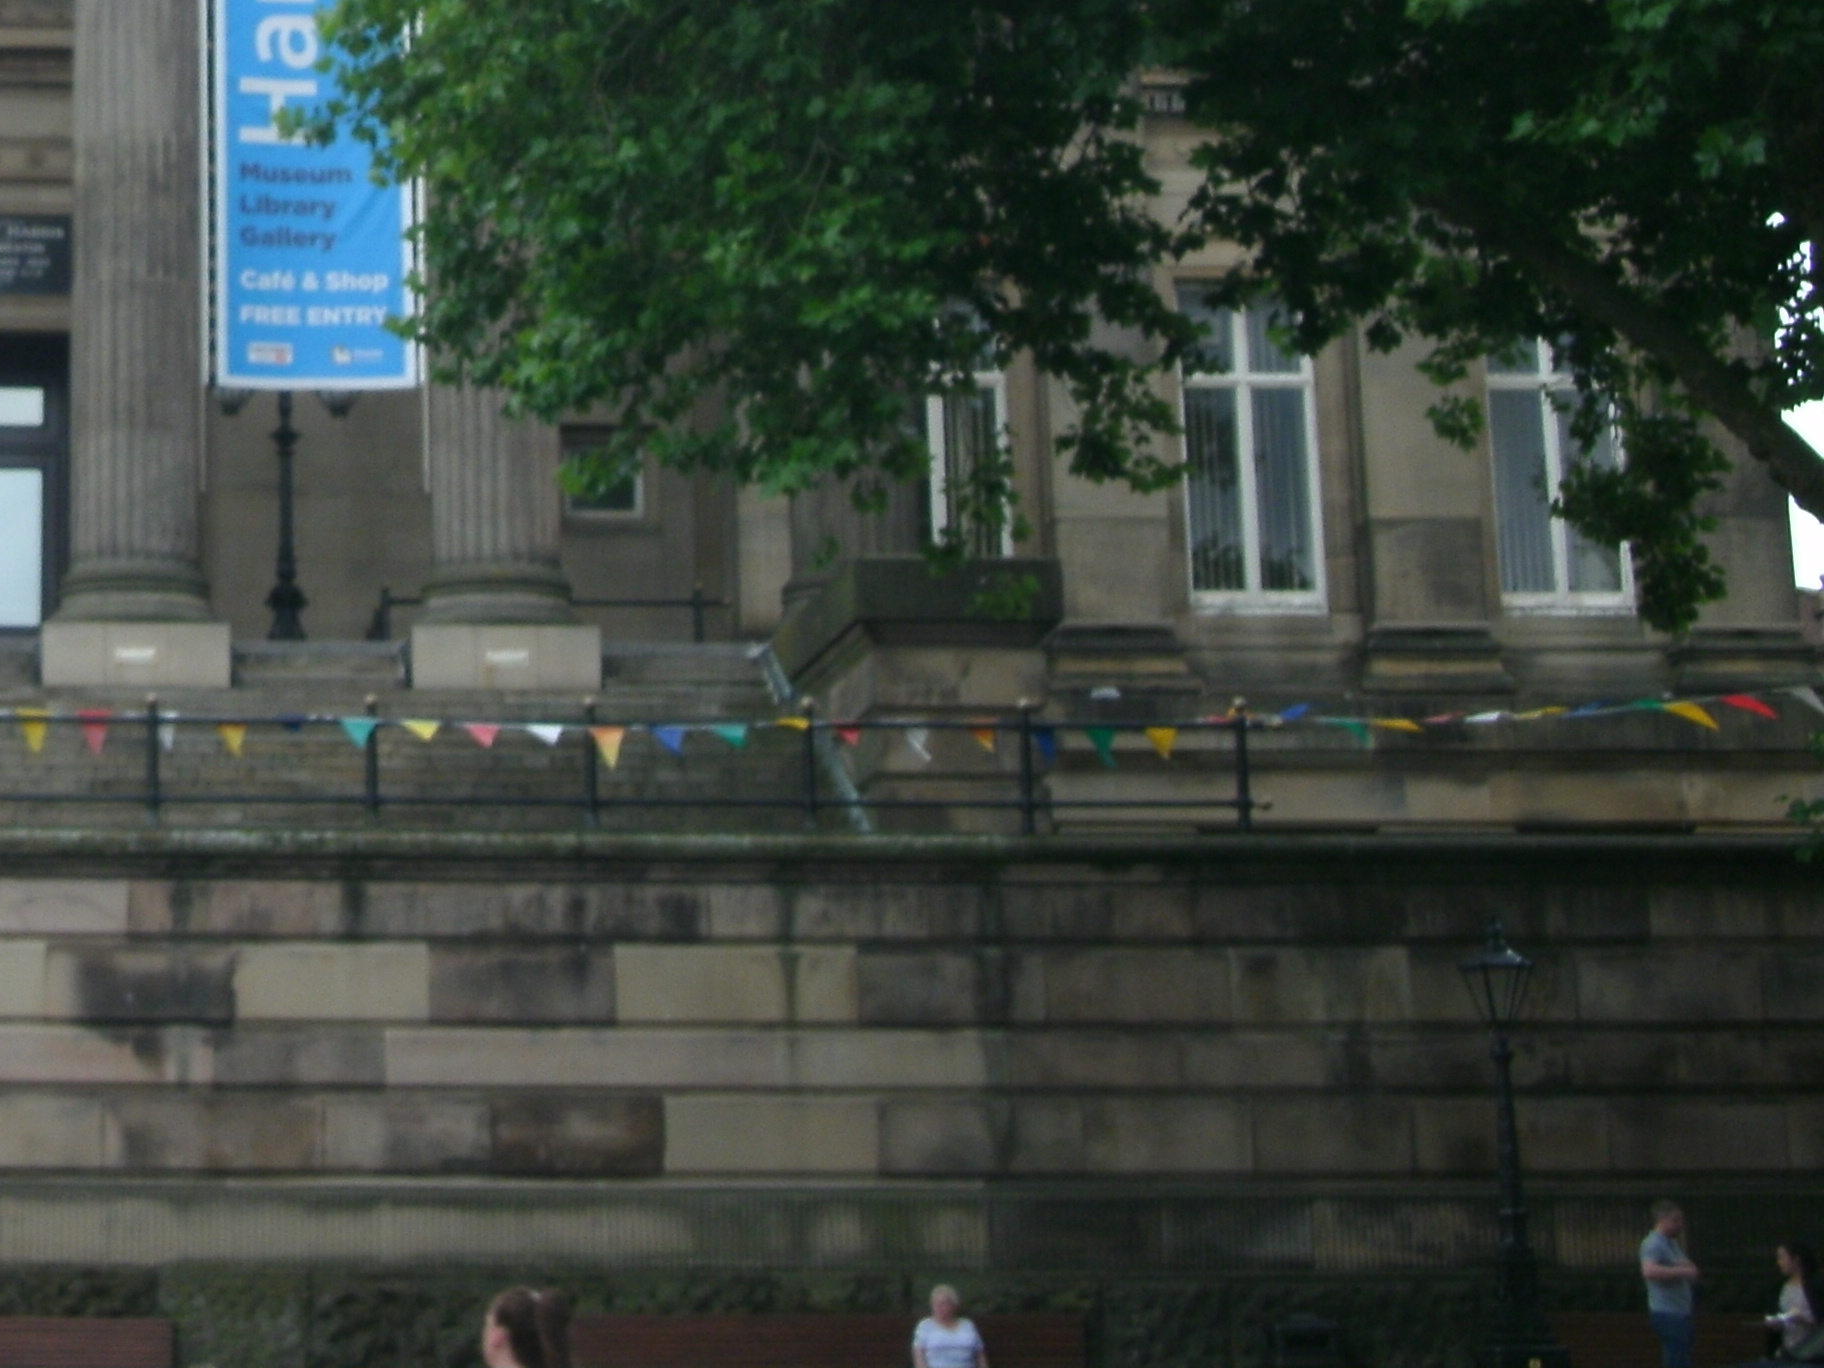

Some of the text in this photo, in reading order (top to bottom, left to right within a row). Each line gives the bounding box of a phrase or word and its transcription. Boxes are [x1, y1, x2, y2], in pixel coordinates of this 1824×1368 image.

[239, 162, 353, 184] Museum
[239, 194, 336, 219] Library
[239, 225, 336, 252] Gallery
[239, 269, 389, 293] Café & Shop
[239, 304, 388, 327] FREE ENTRY
